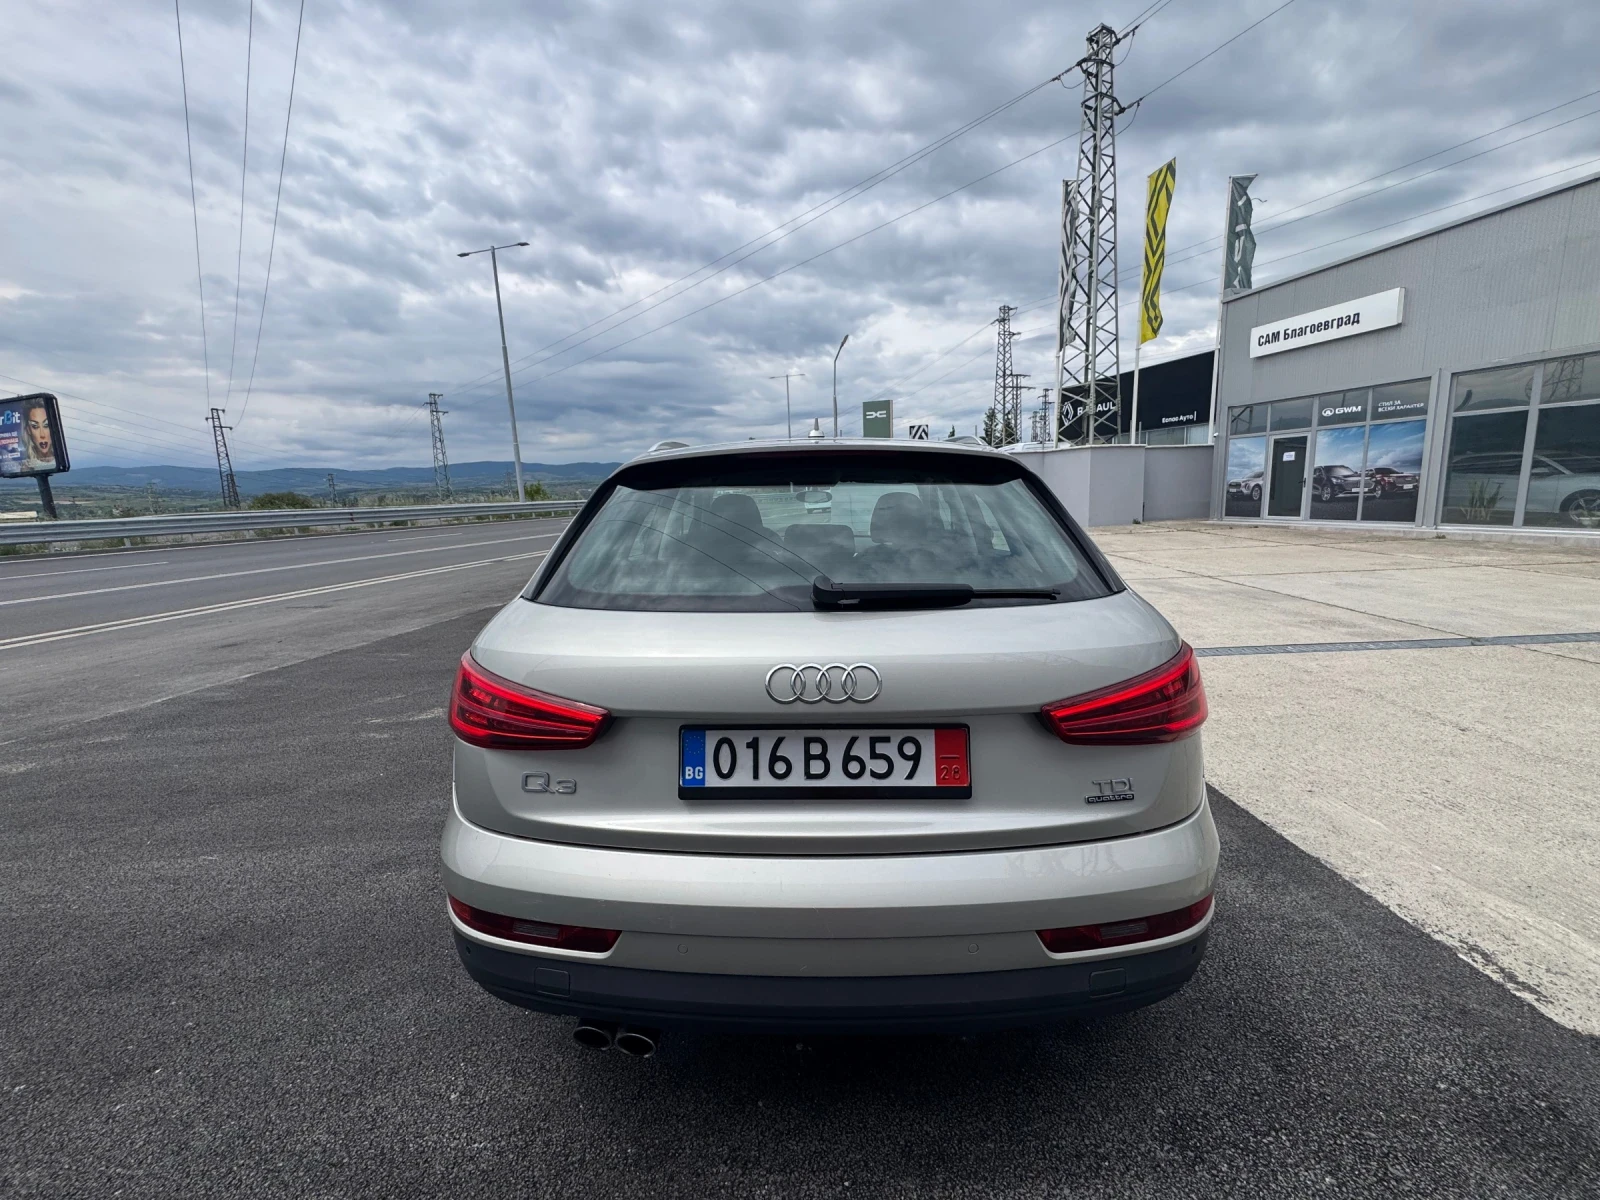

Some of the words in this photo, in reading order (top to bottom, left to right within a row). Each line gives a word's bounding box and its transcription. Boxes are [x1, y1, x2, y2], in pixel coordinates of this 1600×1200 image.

[1257, 329, 1281, 347] САМ
[1283, 312, 1361, 341] Благоевград
[1077, 400, 1120, 416] RAUL
[1335, 405, 1362, 414] GWM
[685, 766, 704, 779] BG
[940, 764, 961, 781] 28
[521, 770, 577, 795] Q3
[1092, 777, 1134, 795] TDI
[1088, 794, 1133, 803] quattro
